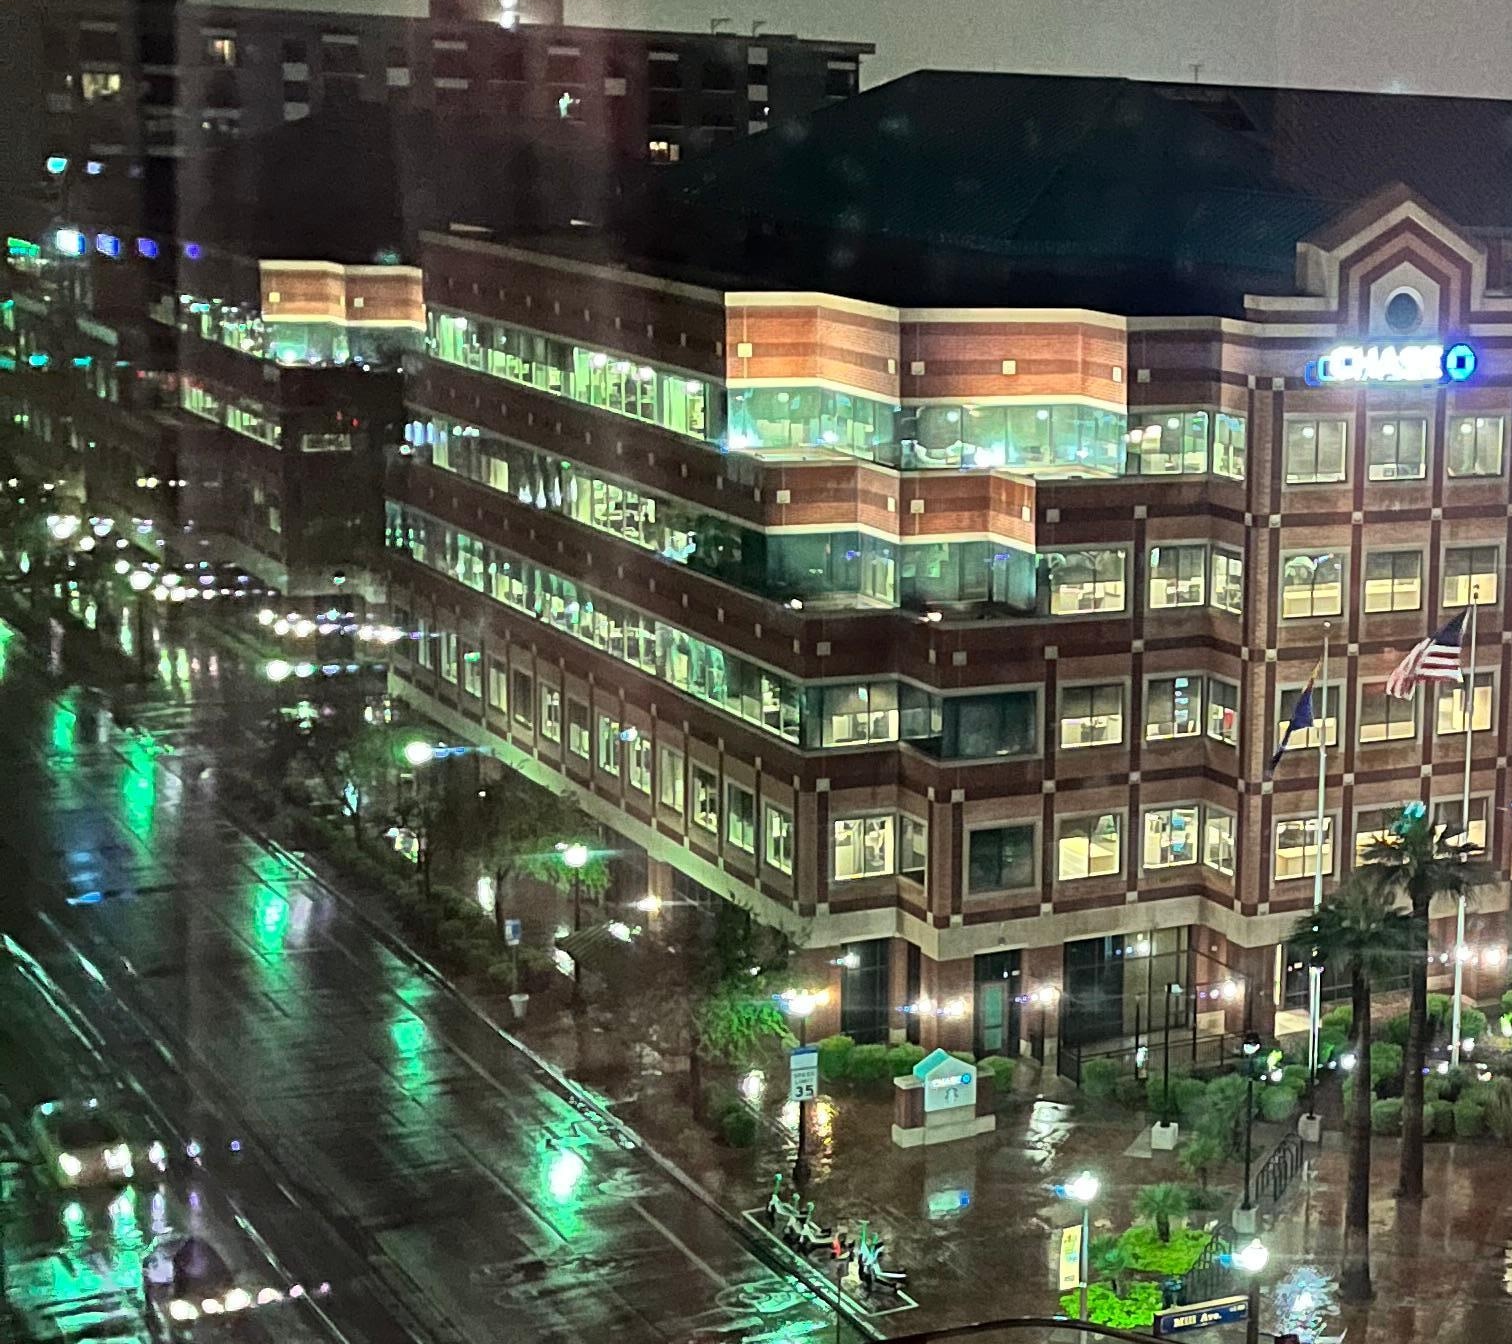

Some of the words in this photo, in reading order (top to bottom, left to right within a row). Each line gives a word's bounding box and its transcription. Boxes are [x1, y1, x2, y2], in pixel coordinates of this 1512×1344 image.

[1326, 344, 1445, 382] CHASE
[794, 1084, 814, 1098] 35
[1173, 1314, 1197, 1328] Mill
[1200, 1312, 1222, 1323] Ave.
